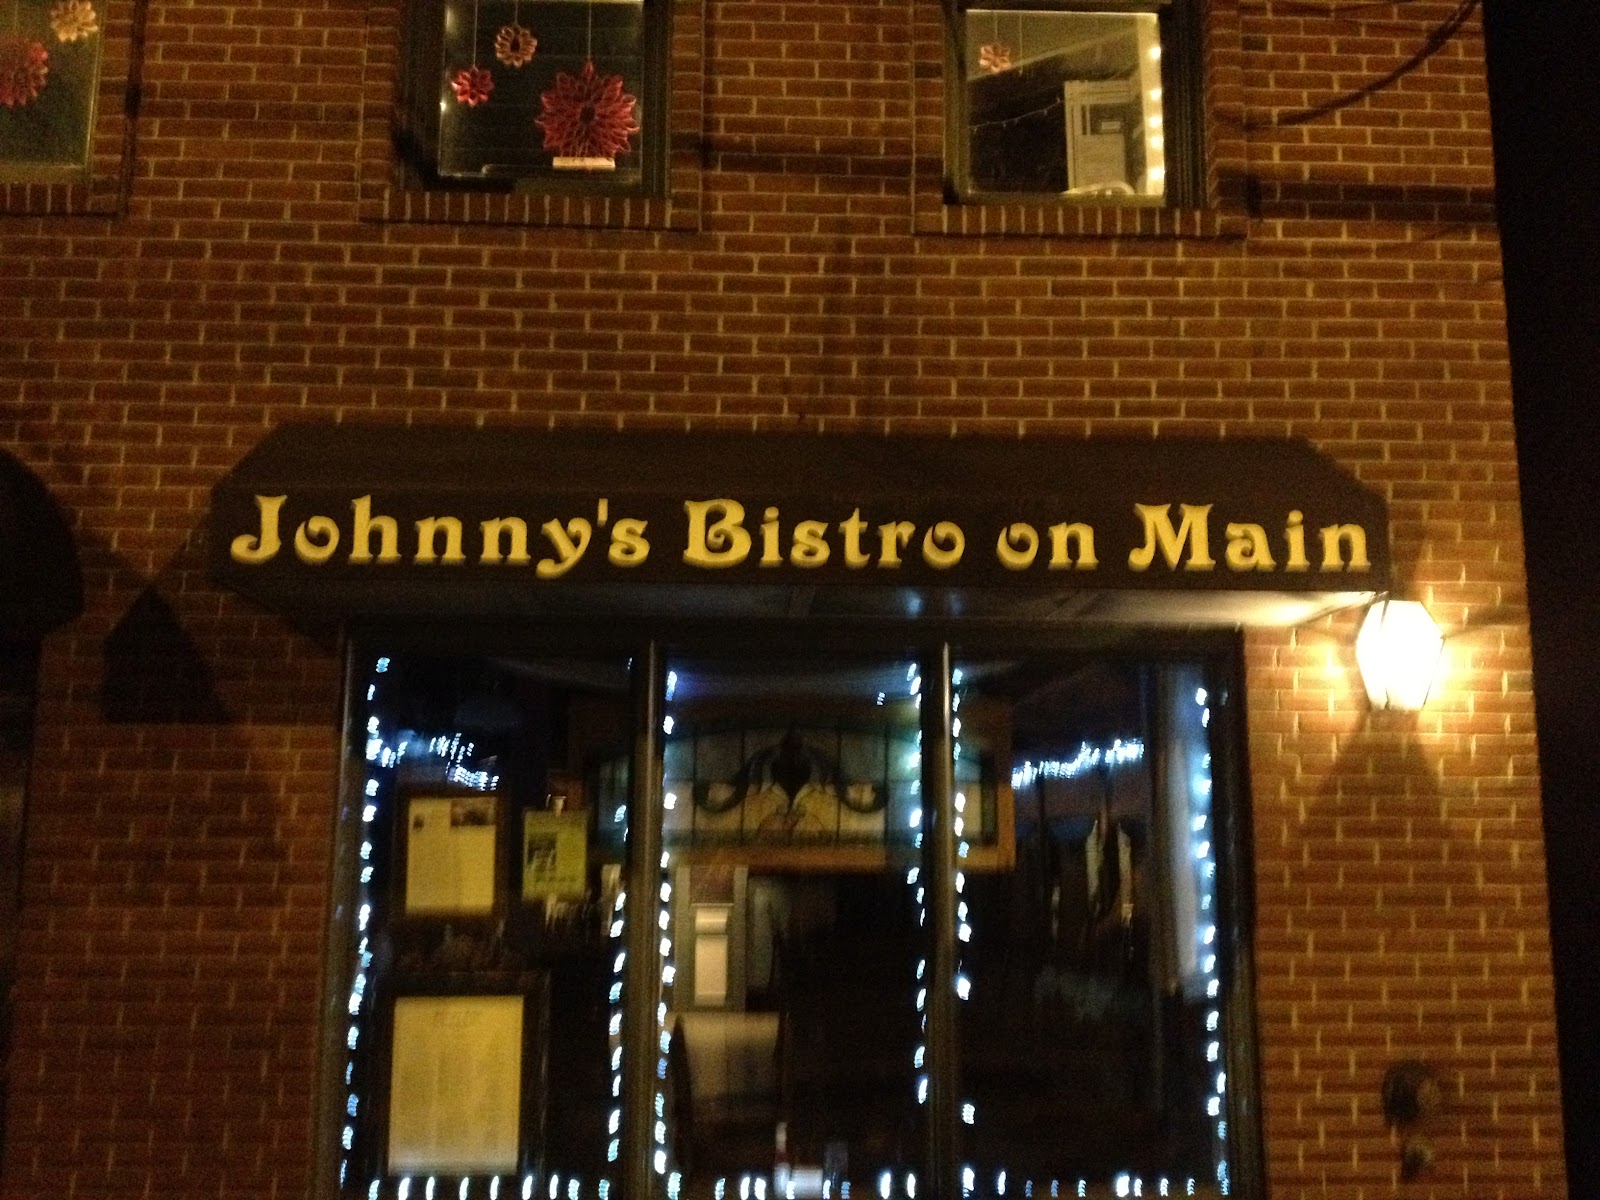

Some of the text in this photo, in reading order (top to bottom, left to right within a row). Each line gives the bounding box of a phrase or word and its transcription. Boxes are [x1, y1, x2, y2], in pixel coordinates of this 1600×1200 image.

[230, 495, 1373, 579] Johnny's Bistro on Main
